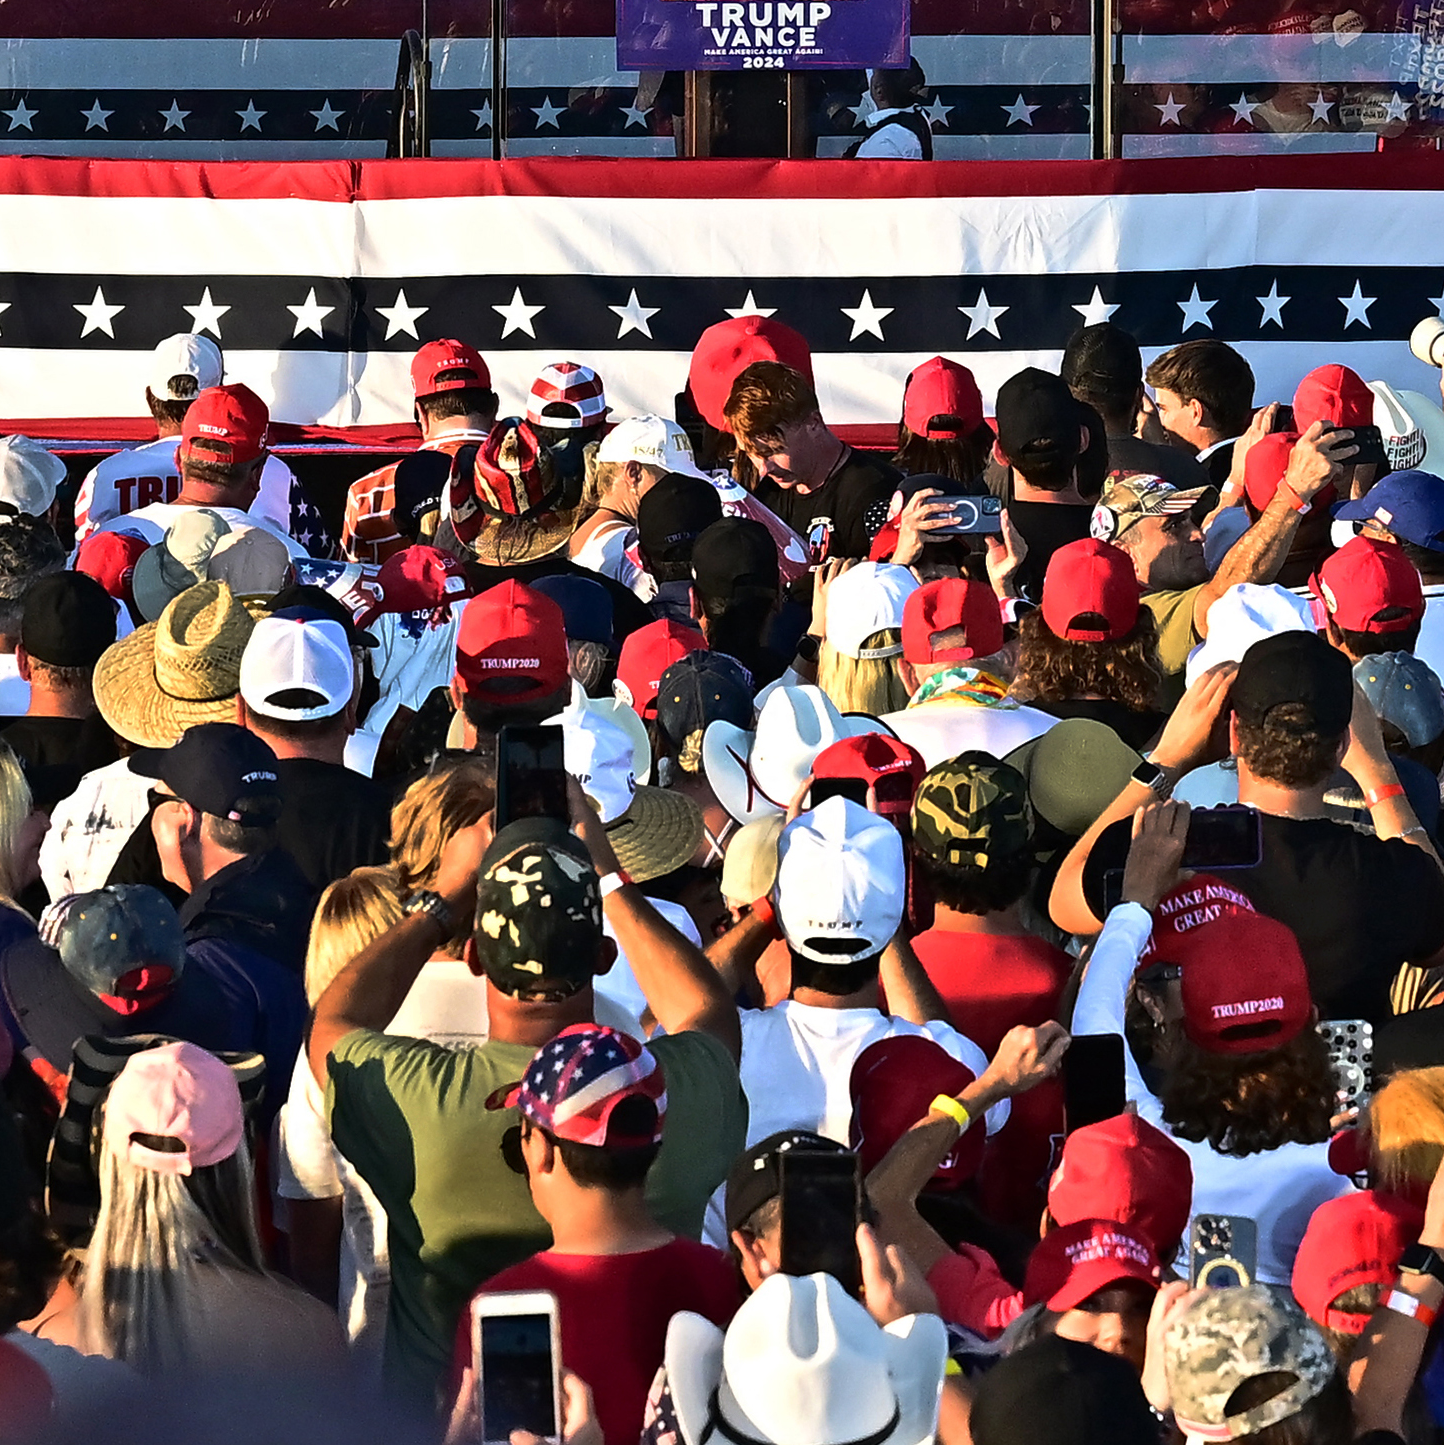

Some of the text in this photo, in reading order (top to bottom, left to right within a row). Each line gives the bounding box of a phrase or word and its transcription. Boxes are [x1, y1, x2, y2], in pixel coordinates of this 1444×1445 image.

[696, 3, 831, 26] TRUMP
[711, 27, 815, 47] VANCE
[743, 57, 784, 68] 2024
[198, 424, 227, 436] TRUMP
[1389, 433, 1421, 446] FIGHT!
[1388, 445, 1421, 459] FIGHT!
[481, 658, 539, 668] TRUMP2020
[1159, 888, 1201, 915] MAKE
[1174, 907, 1219, 932] GREAT
[1212, 997, 1283, 1018] TRUMP2020
